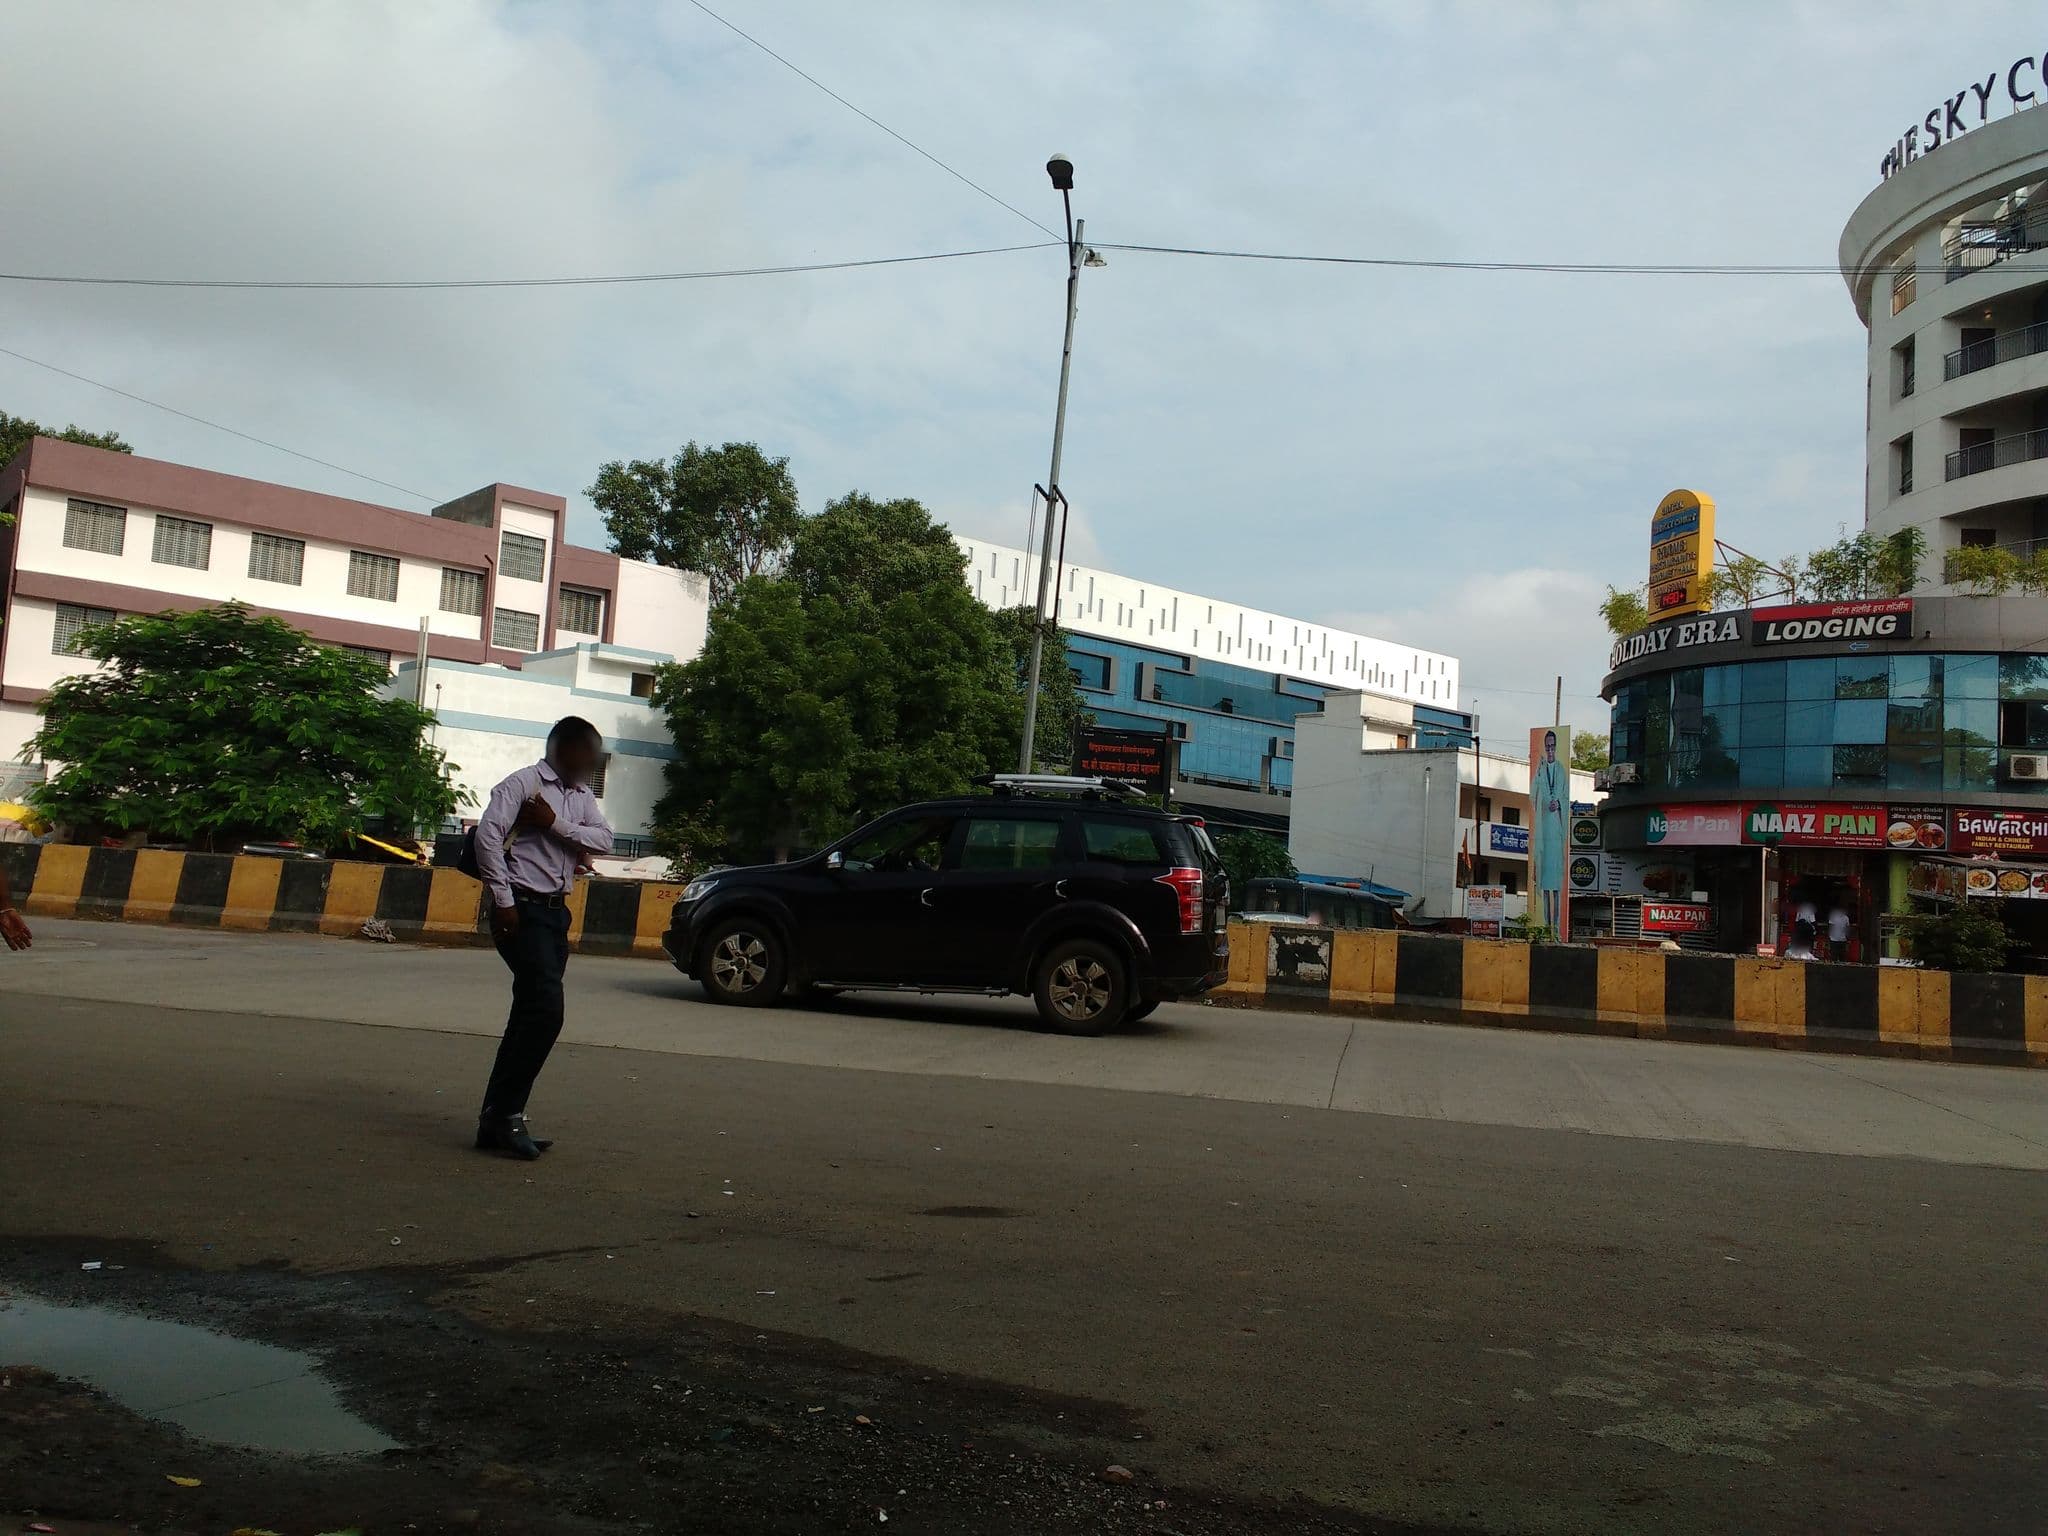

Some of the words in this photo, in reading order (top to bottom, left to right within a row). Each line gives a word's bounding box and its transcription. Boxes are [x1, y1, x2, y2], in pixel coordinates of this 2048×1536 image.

[1677, 616, 1741, 648] ERA
[1766, 614, 1896, 641] LODGING
[1649, 816, 1688, 833] Naaz
[1694, 815, 1730, 832] Pan
[1752, 813, 1816, 834] NAAZ
[1823, 814, 1877, 836] PAN
[1958, 817, 2048, 837] BAWARCHI
[1651, 908, 1682, 921] NAAZ
[1684, 910, 1706, 922] PAN
